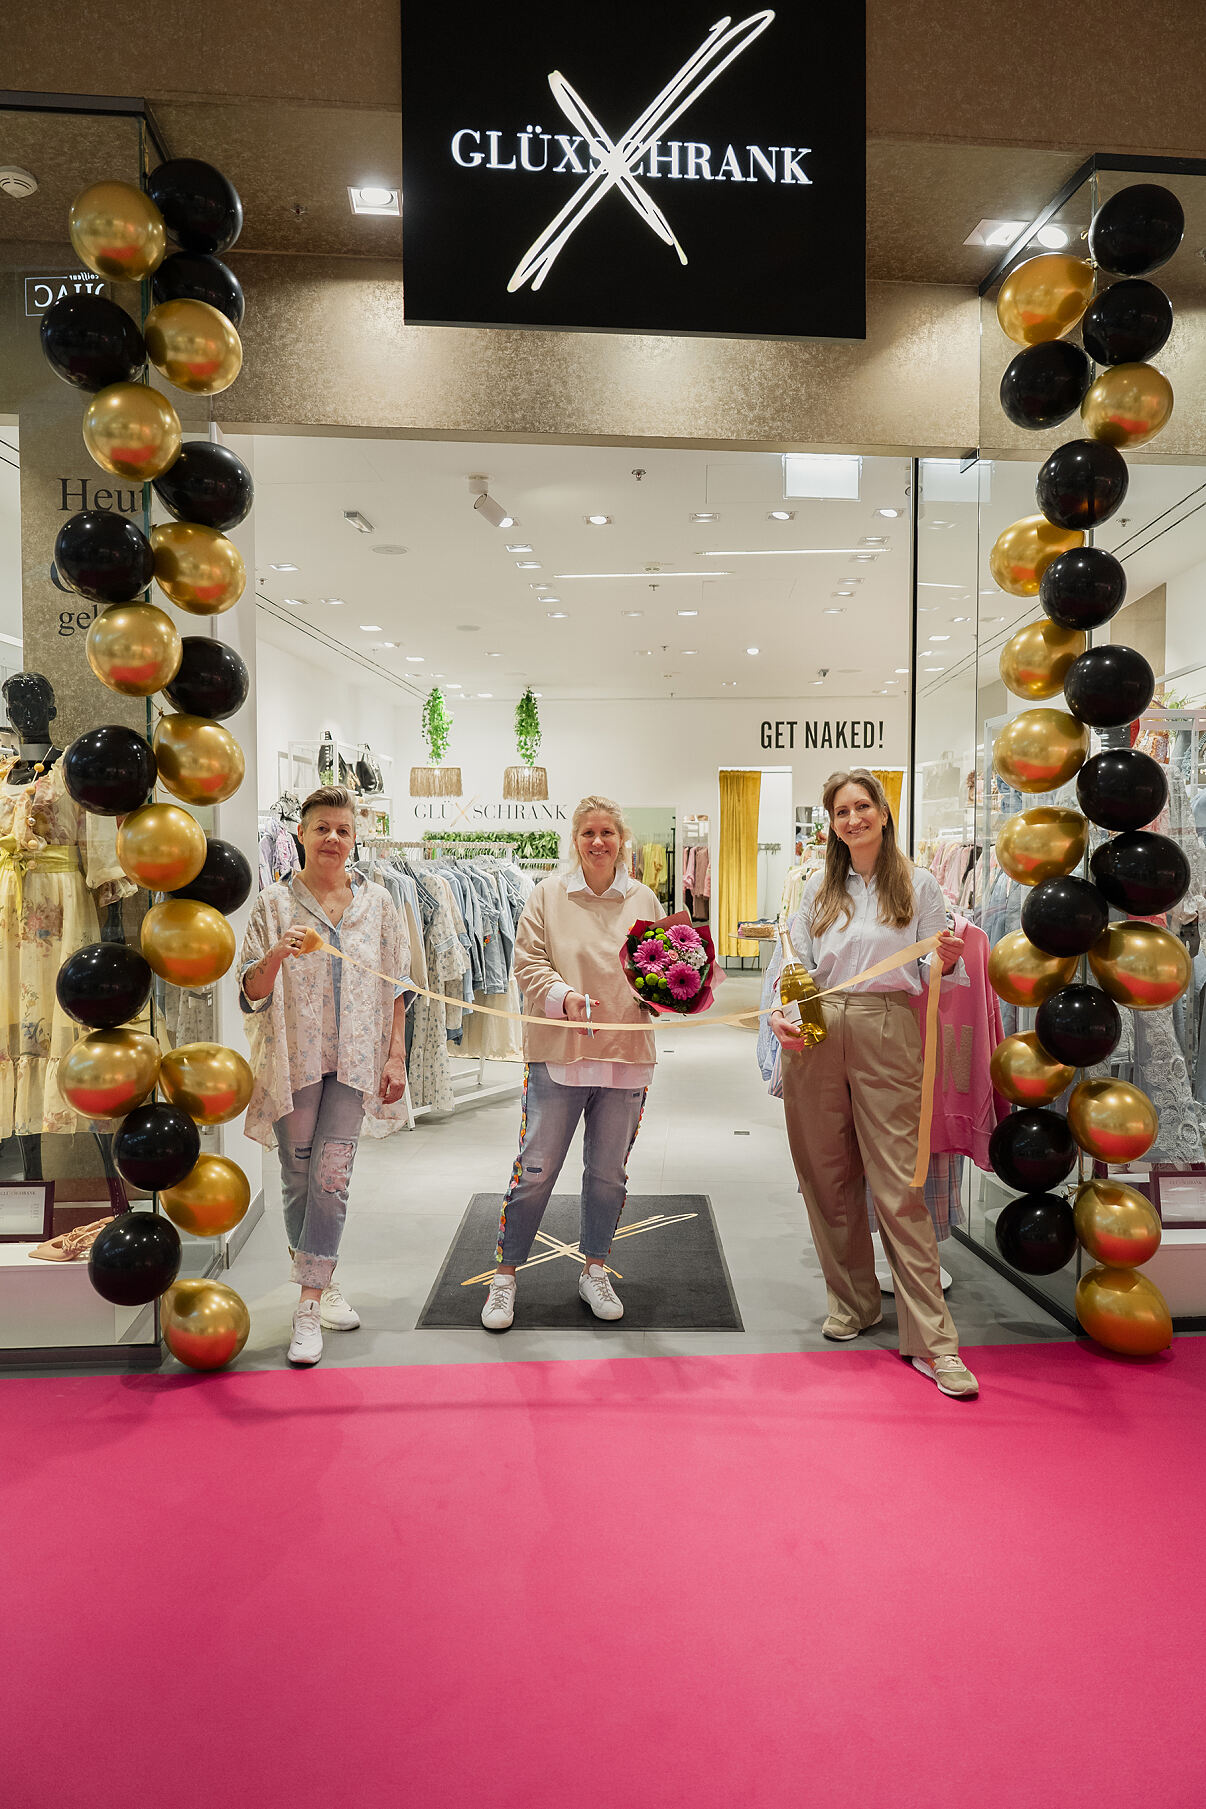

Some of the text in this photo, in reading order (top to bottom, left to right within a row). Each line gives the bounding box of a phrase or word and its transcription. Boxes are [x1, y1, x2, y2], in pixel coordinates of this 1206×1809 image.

[57, 477, 143, 513] Heu
[760, 720, 884, 749] GET NAKED!
